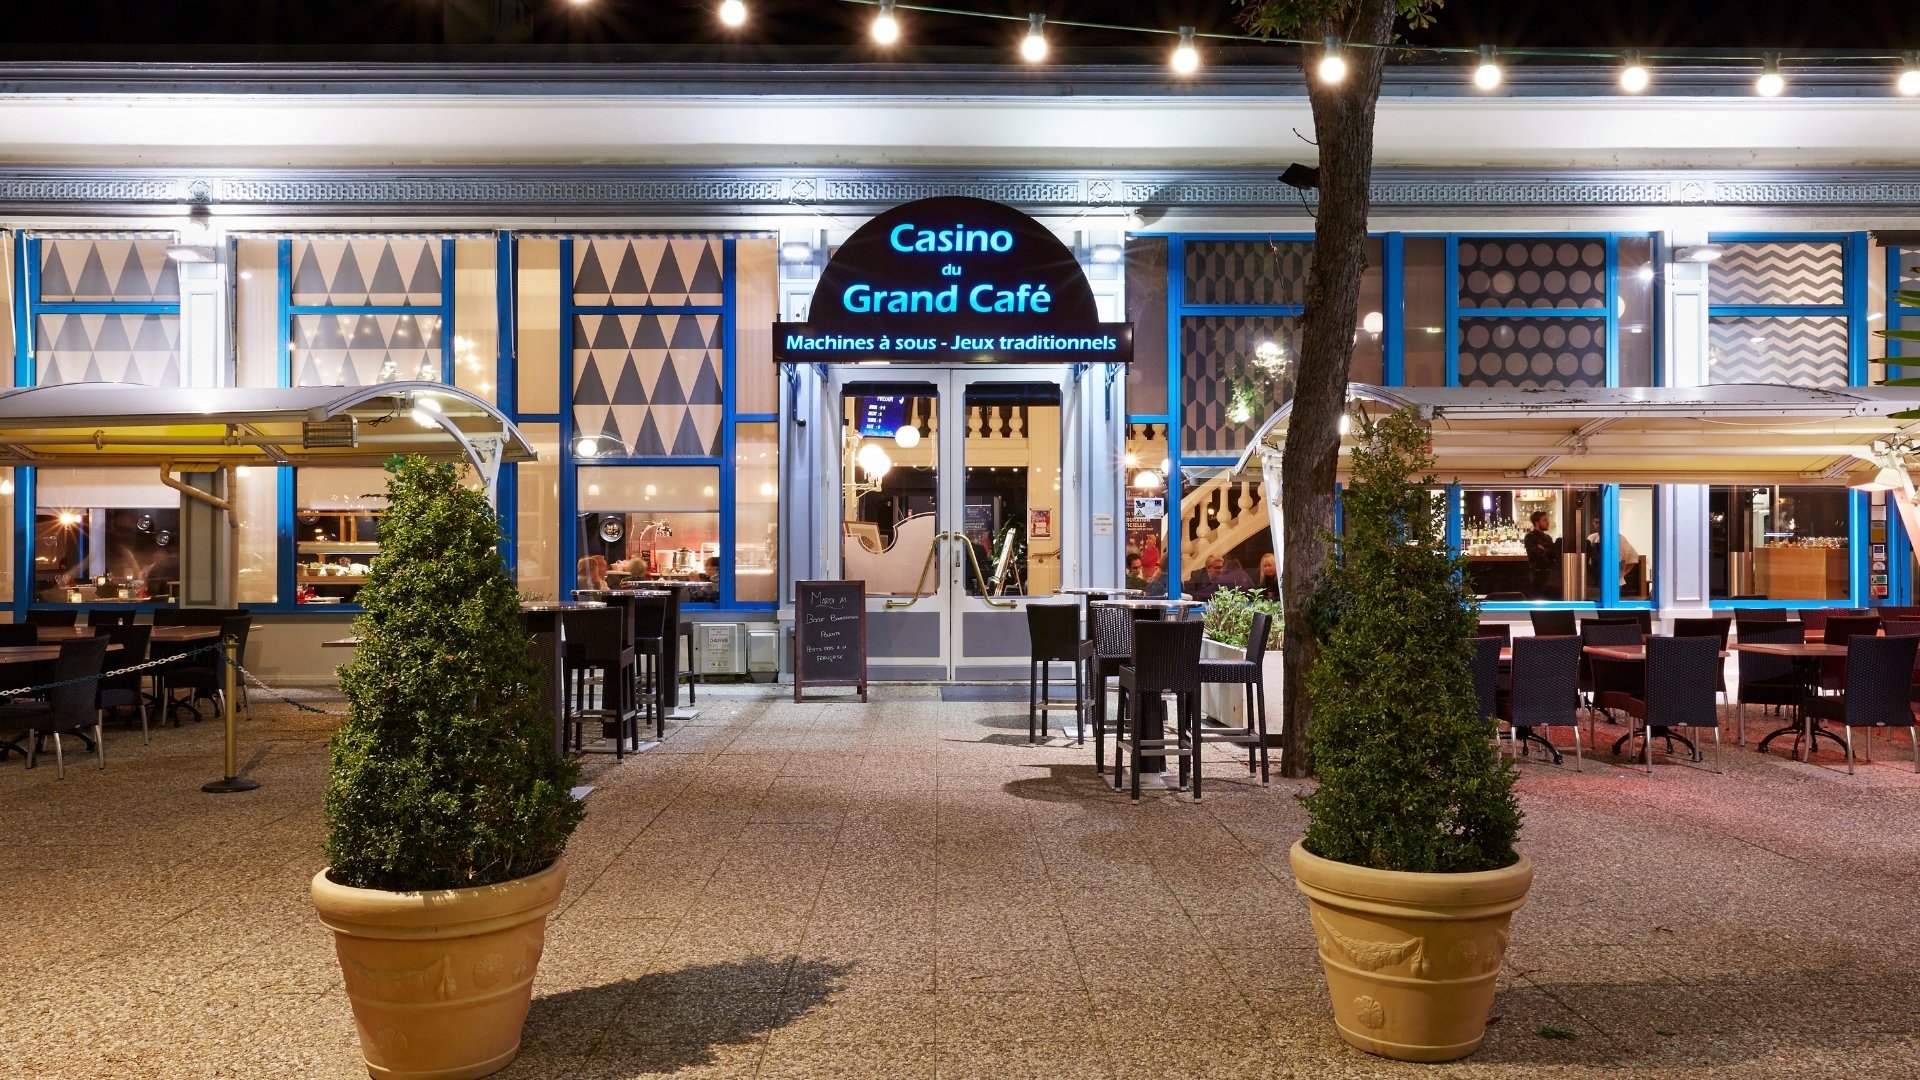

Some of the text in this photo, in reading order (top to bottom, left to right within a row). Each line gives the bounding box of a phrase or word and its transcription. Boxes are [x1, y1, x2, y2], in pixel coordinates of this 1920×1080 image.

[890, 223, 1014, 253] Casino
[941, 263, 962, 276] du
[843, 283, 1051, 313] Grand Café
[786, 335, 875, 351] Machines
[879, 334, 891, 351] à
[894, 338, 937, 351] sous
[950, 335, 995, 351] Jeux
[998, 335, 1117, 351] traditionnels
